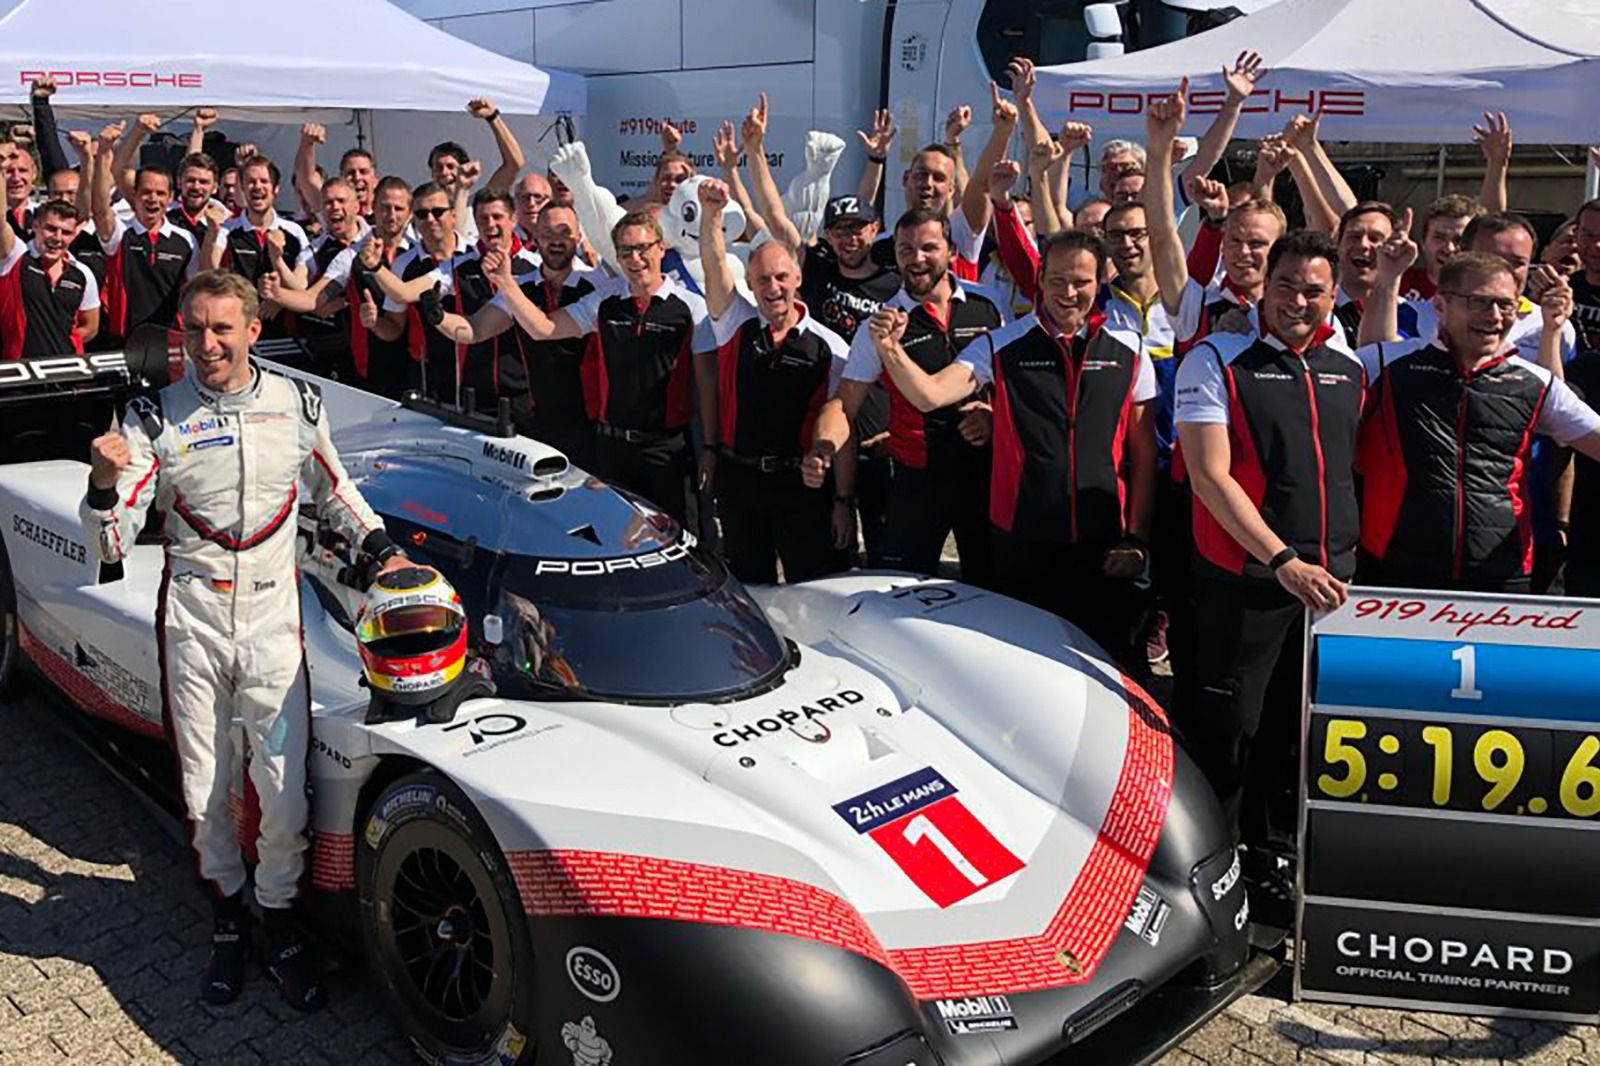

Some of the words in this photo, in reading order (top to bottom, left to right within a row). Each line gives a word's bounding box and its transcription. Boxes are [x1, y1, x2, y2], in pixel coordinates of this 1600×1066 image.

[620, 150, 660, 168] Missio
[832, 197, 859, 215] YZ
[13, 514, 87, 564] SCHAEFFLER
[1354, 599, 1427, 620] 919
[1429, 603, 1584, 637] hybrid
[1450, 644, 1483, 701] 1
[712, 690, 865, 747] CHOPARD
[312, 736, 352, 769] OPARD
[881, 796, 905, 813] LE
[902, 779, 946, 805] MANS
[902, 813, 990, 888] 1
[1336, 931, 1574, 975] CHOPARD
[1335, 965, 1416, 982] OFFICIAL
[1417, 972, 1481, 988] TIMING
[1484, 978, 1571, 995] PARTNER
[935, 997, 993, 1018] Mobil
